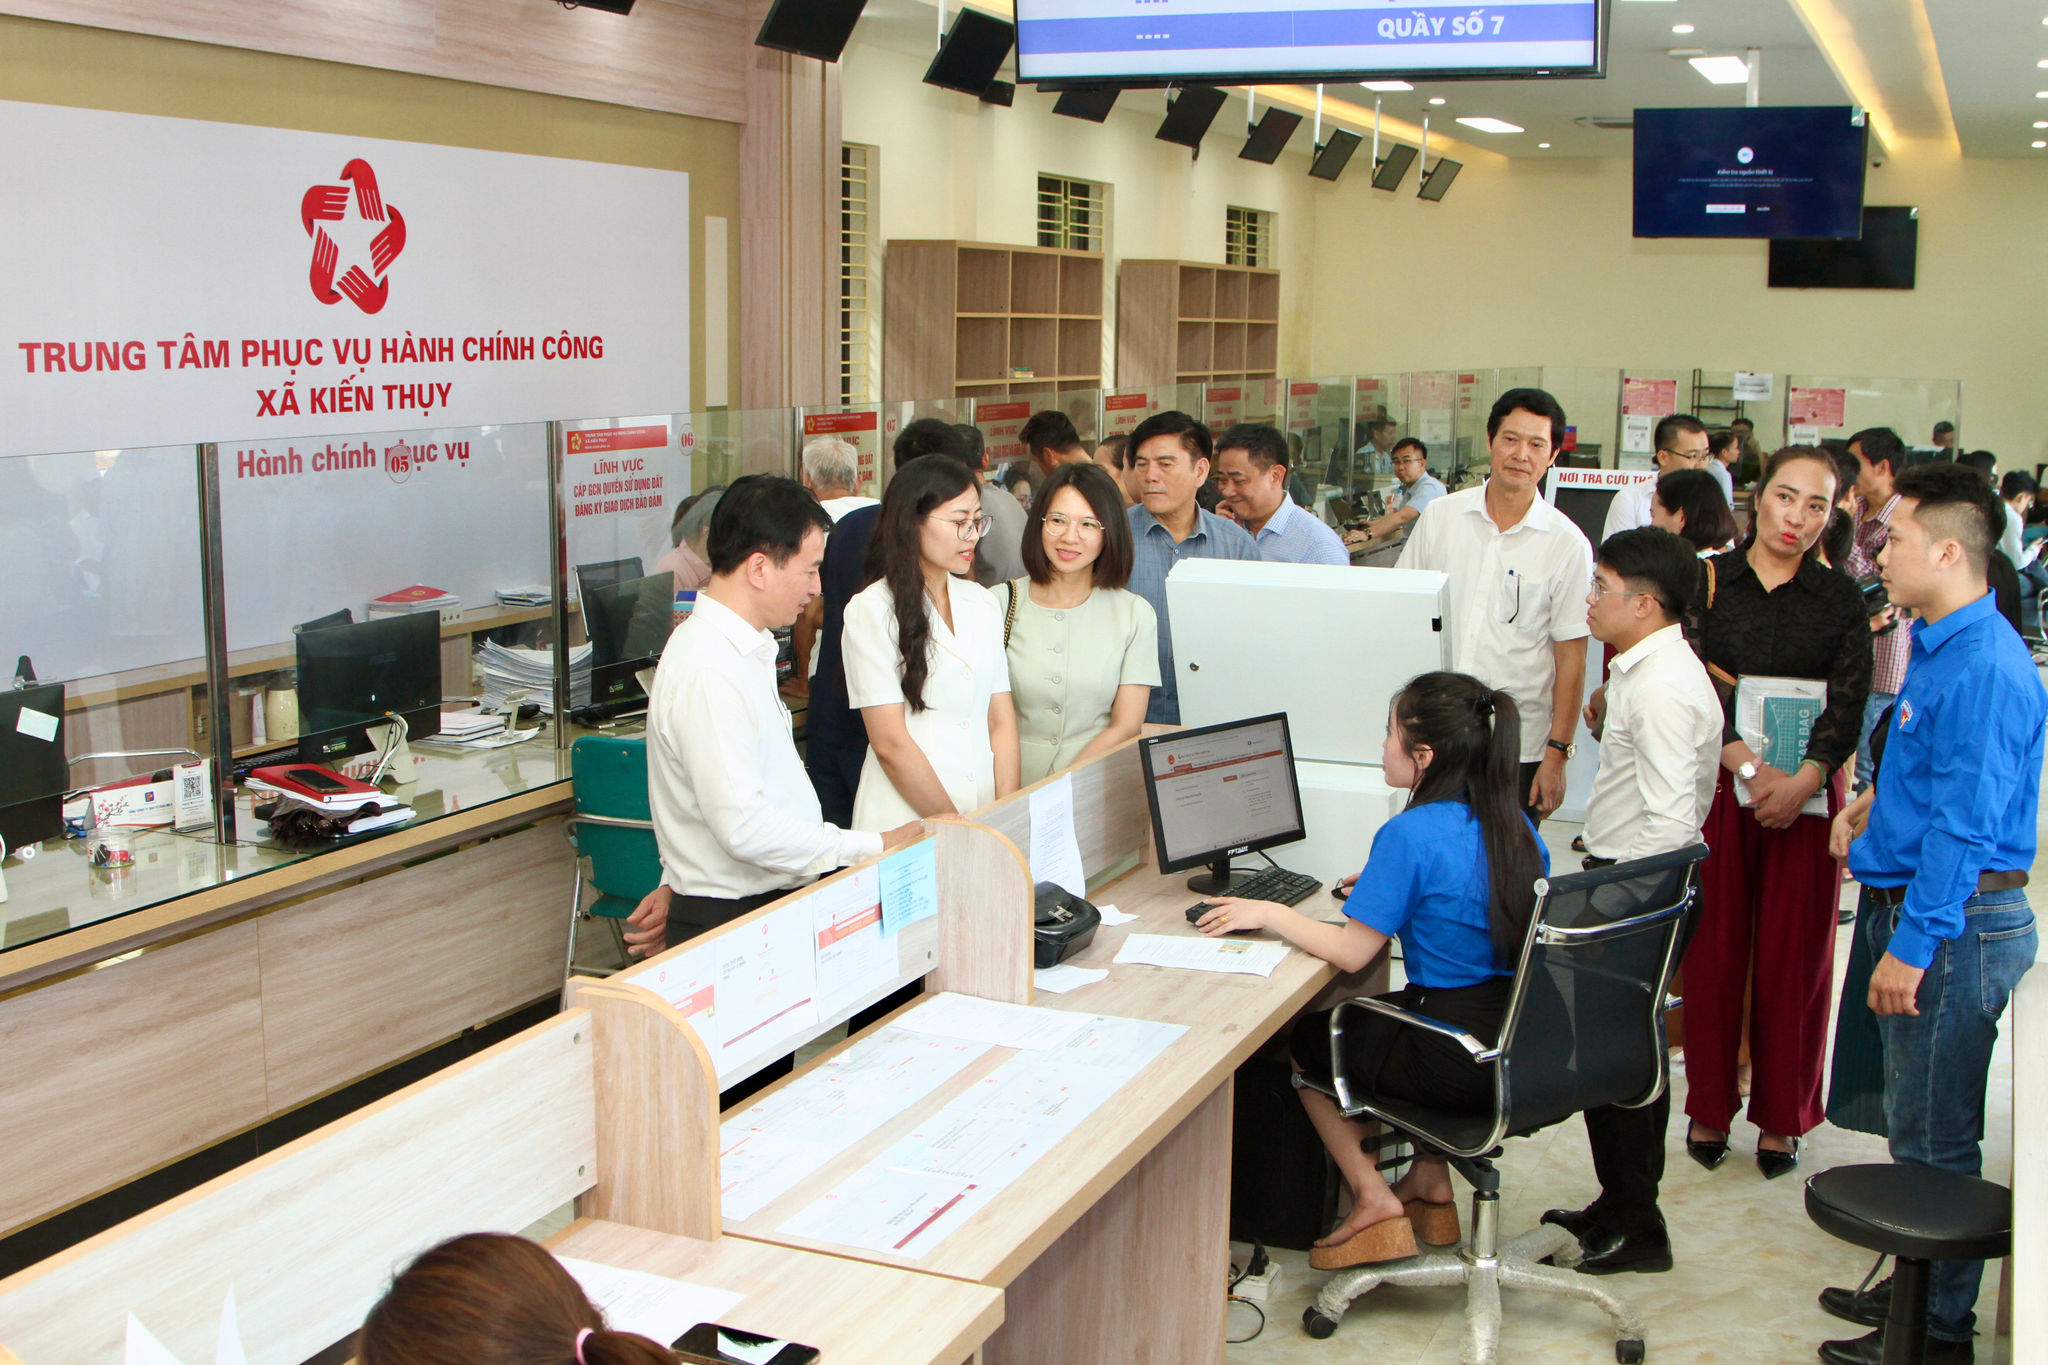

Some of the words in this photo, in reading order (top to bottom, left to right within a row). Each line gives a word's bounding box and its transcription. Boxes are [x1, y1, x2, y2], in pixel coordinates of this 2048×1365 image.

[1377, 10, 1446, 40] QUẦY
[1452, 8, 1485, 36] SỐ
[1490, 15, 1505, 36] 7
[17, 340, 147, 374] TRUNG
[156, 331, 230, 370] TÂM
[241, 338, 324, 376] PHỤC
[332, 338, 372, 373] VỤ
[381, 330, 454, 364] HÀNH
[462, 330, 535, 362] CHÍNH
[541, 330, 604, 360] CÔNG
[256, 380, 301, 418] XÃ
[310, 374, 374, 415] KIẾN
[382, 382, 453, 417] THỤY
[681, 432, 695, 447] 06
[237, 447, 303, 479] Hành
[311, 441, 377, 473] chính
[445, 441, 470, 468] vụ
[390, 455, 409, 474] 05
[593, 458, 619, 475] LĨNH
[621, 457, 644, 475] VỰC
[1559, 472, 1579, 483] NƠI
[1582, 473, 1602, 484] TRA
[1632, 474, 1653, 484] TH
[588, 483, 602, 496] GCN
[603, 500, 619, 514] GIAO
[1799, 709, 1810, 736] BAG
